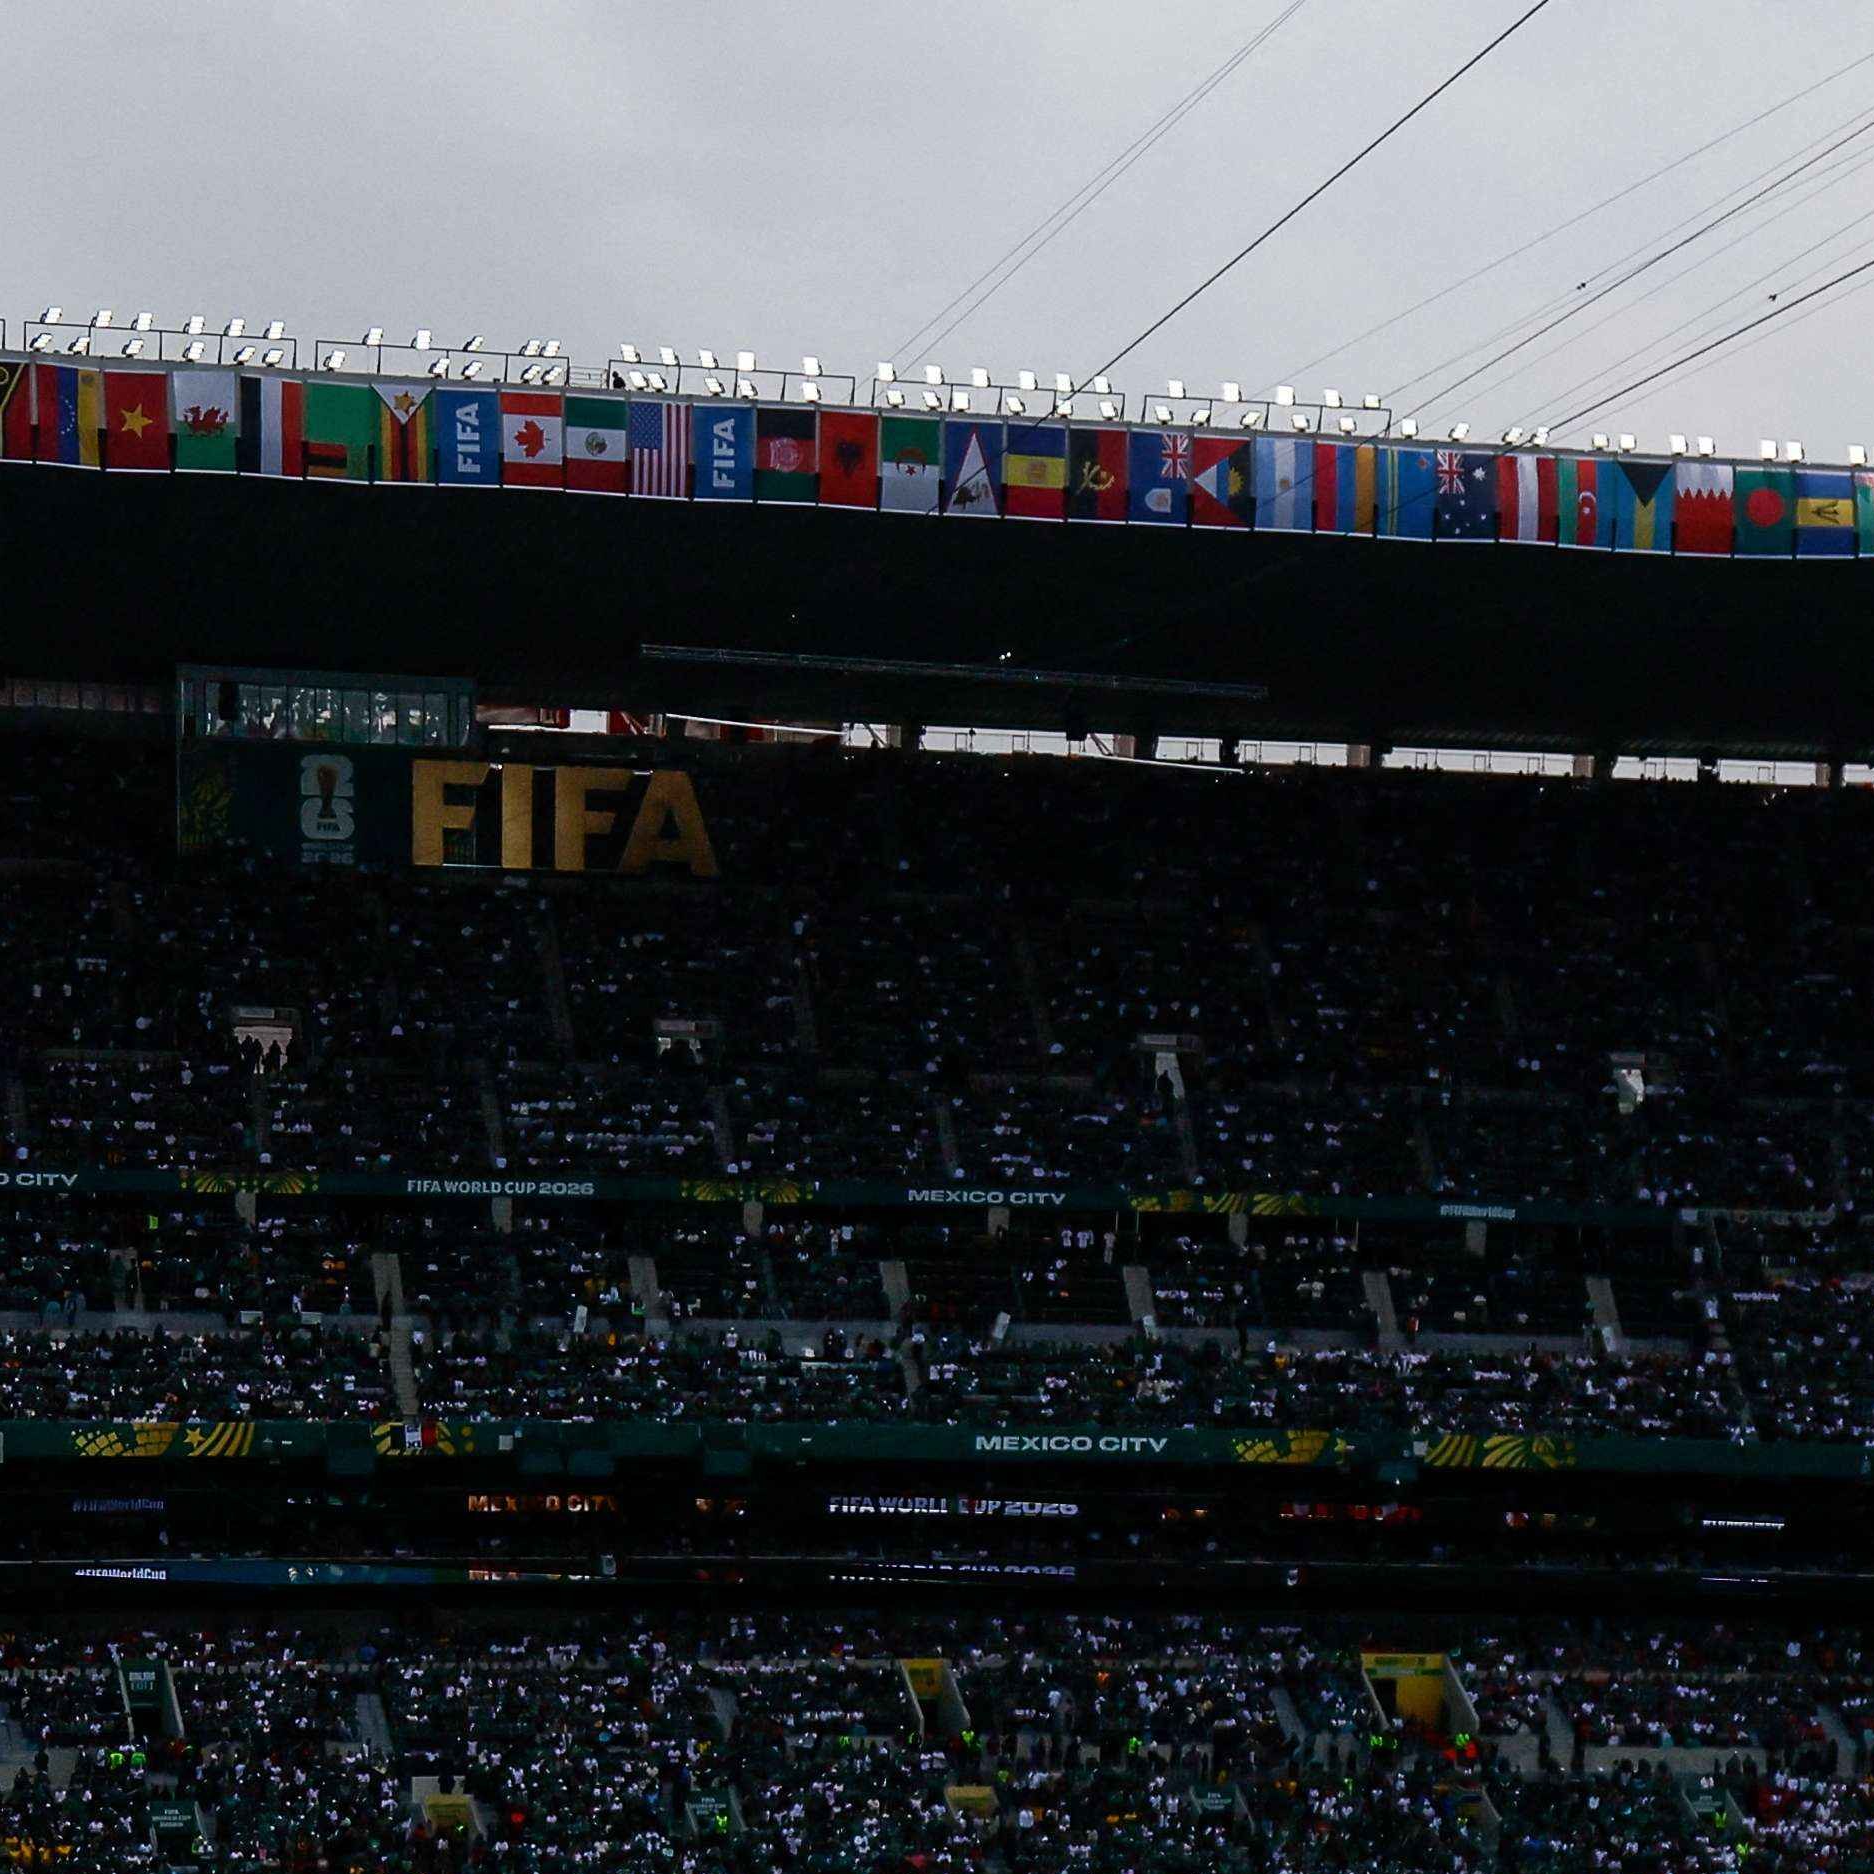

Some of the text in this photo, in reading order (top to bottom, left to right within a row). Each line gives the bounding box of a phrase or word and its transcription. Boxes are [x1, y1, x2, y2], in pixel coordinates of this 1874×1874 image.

[457, 402, 481, 474] FIFA
[712, 417, 736, 489] FIFA
[412, 759, 722, 880] FIFA
[15, 1171, 78, 1187] CITY
[407, 1179, 595, 1196] FIFA WORLD CUP 2026
[908, 1188, 1067, 1206] MEXICO CITY
[976, 1434, 1169, 1453] MEXICO CITY
[828, 1495, 876, 1515] FIFA
